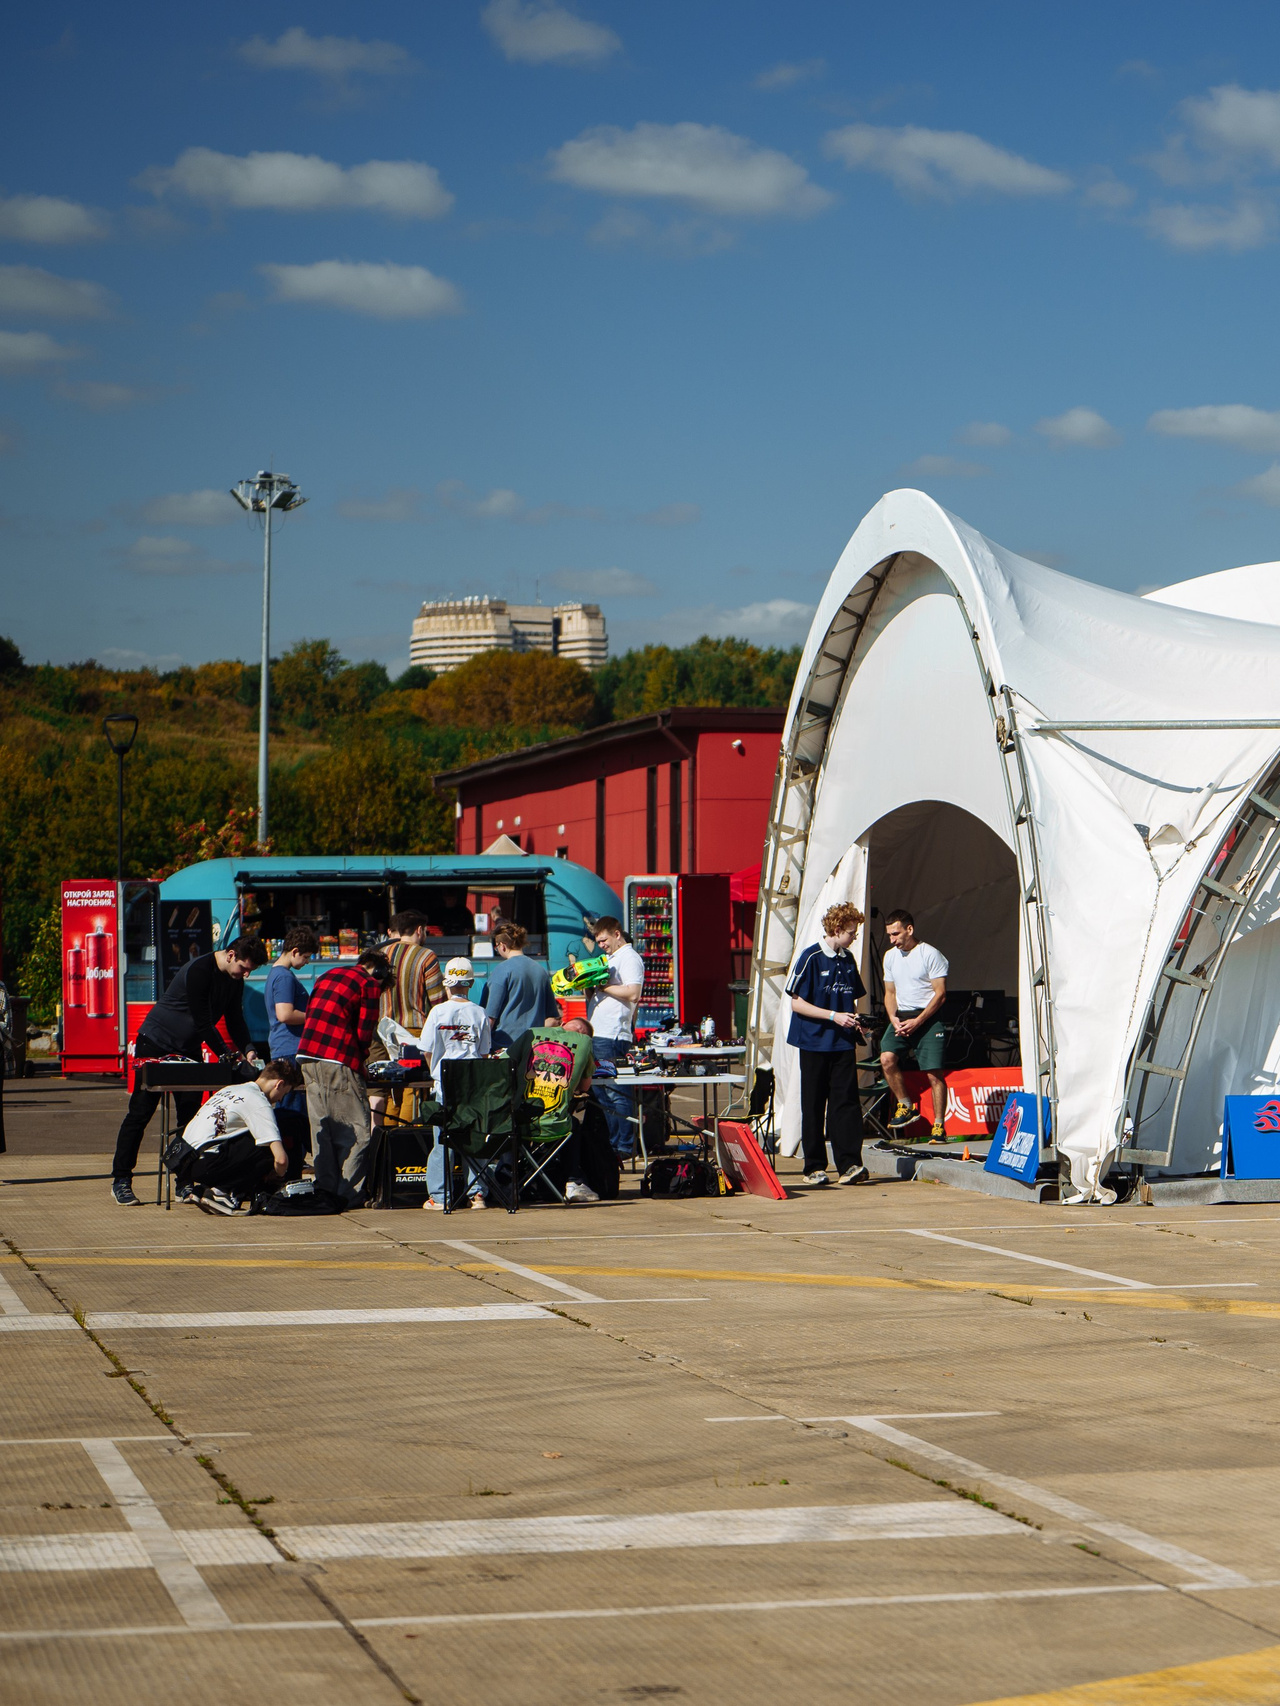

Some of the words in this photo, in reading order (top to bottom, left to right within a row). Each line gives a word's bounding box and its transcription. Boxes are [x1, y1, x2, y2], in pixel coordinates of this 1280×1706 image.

[63, 889, 92, 899] ОТКРОЙ
[92, 890, 115, 899] ЗАРЯД
[67, 899, 112, 907] НАСТРОЕНИЯ
[971, 1086, 1024, 1104] МОСК
[974, 1104, 1005, 1123] СПО
[395, 1166, 428, 1174] YOK
